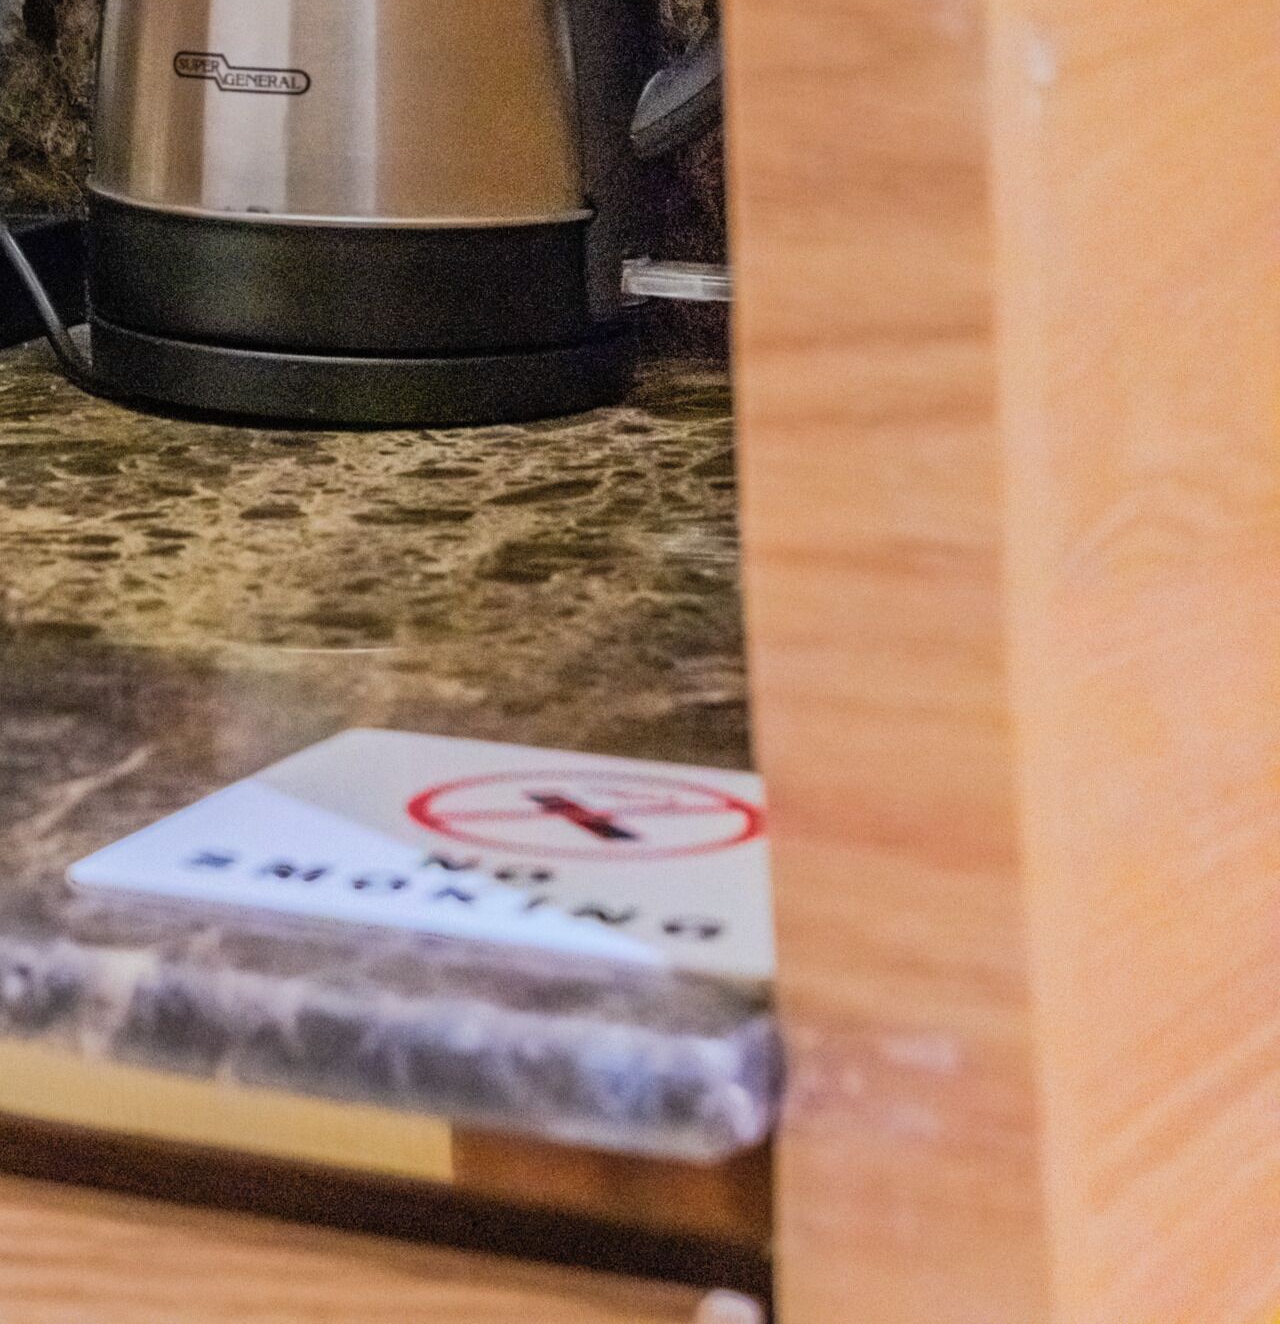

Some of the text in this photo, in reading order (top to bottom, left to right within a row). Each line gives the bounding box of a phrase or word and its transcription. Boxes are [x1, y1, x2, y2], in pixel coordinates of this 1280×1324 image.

[178, 58, 302, 90] SUPER GENERAL
[423, 850, 557, 885] NO
[185, 848, 726, 942] SMOKING
